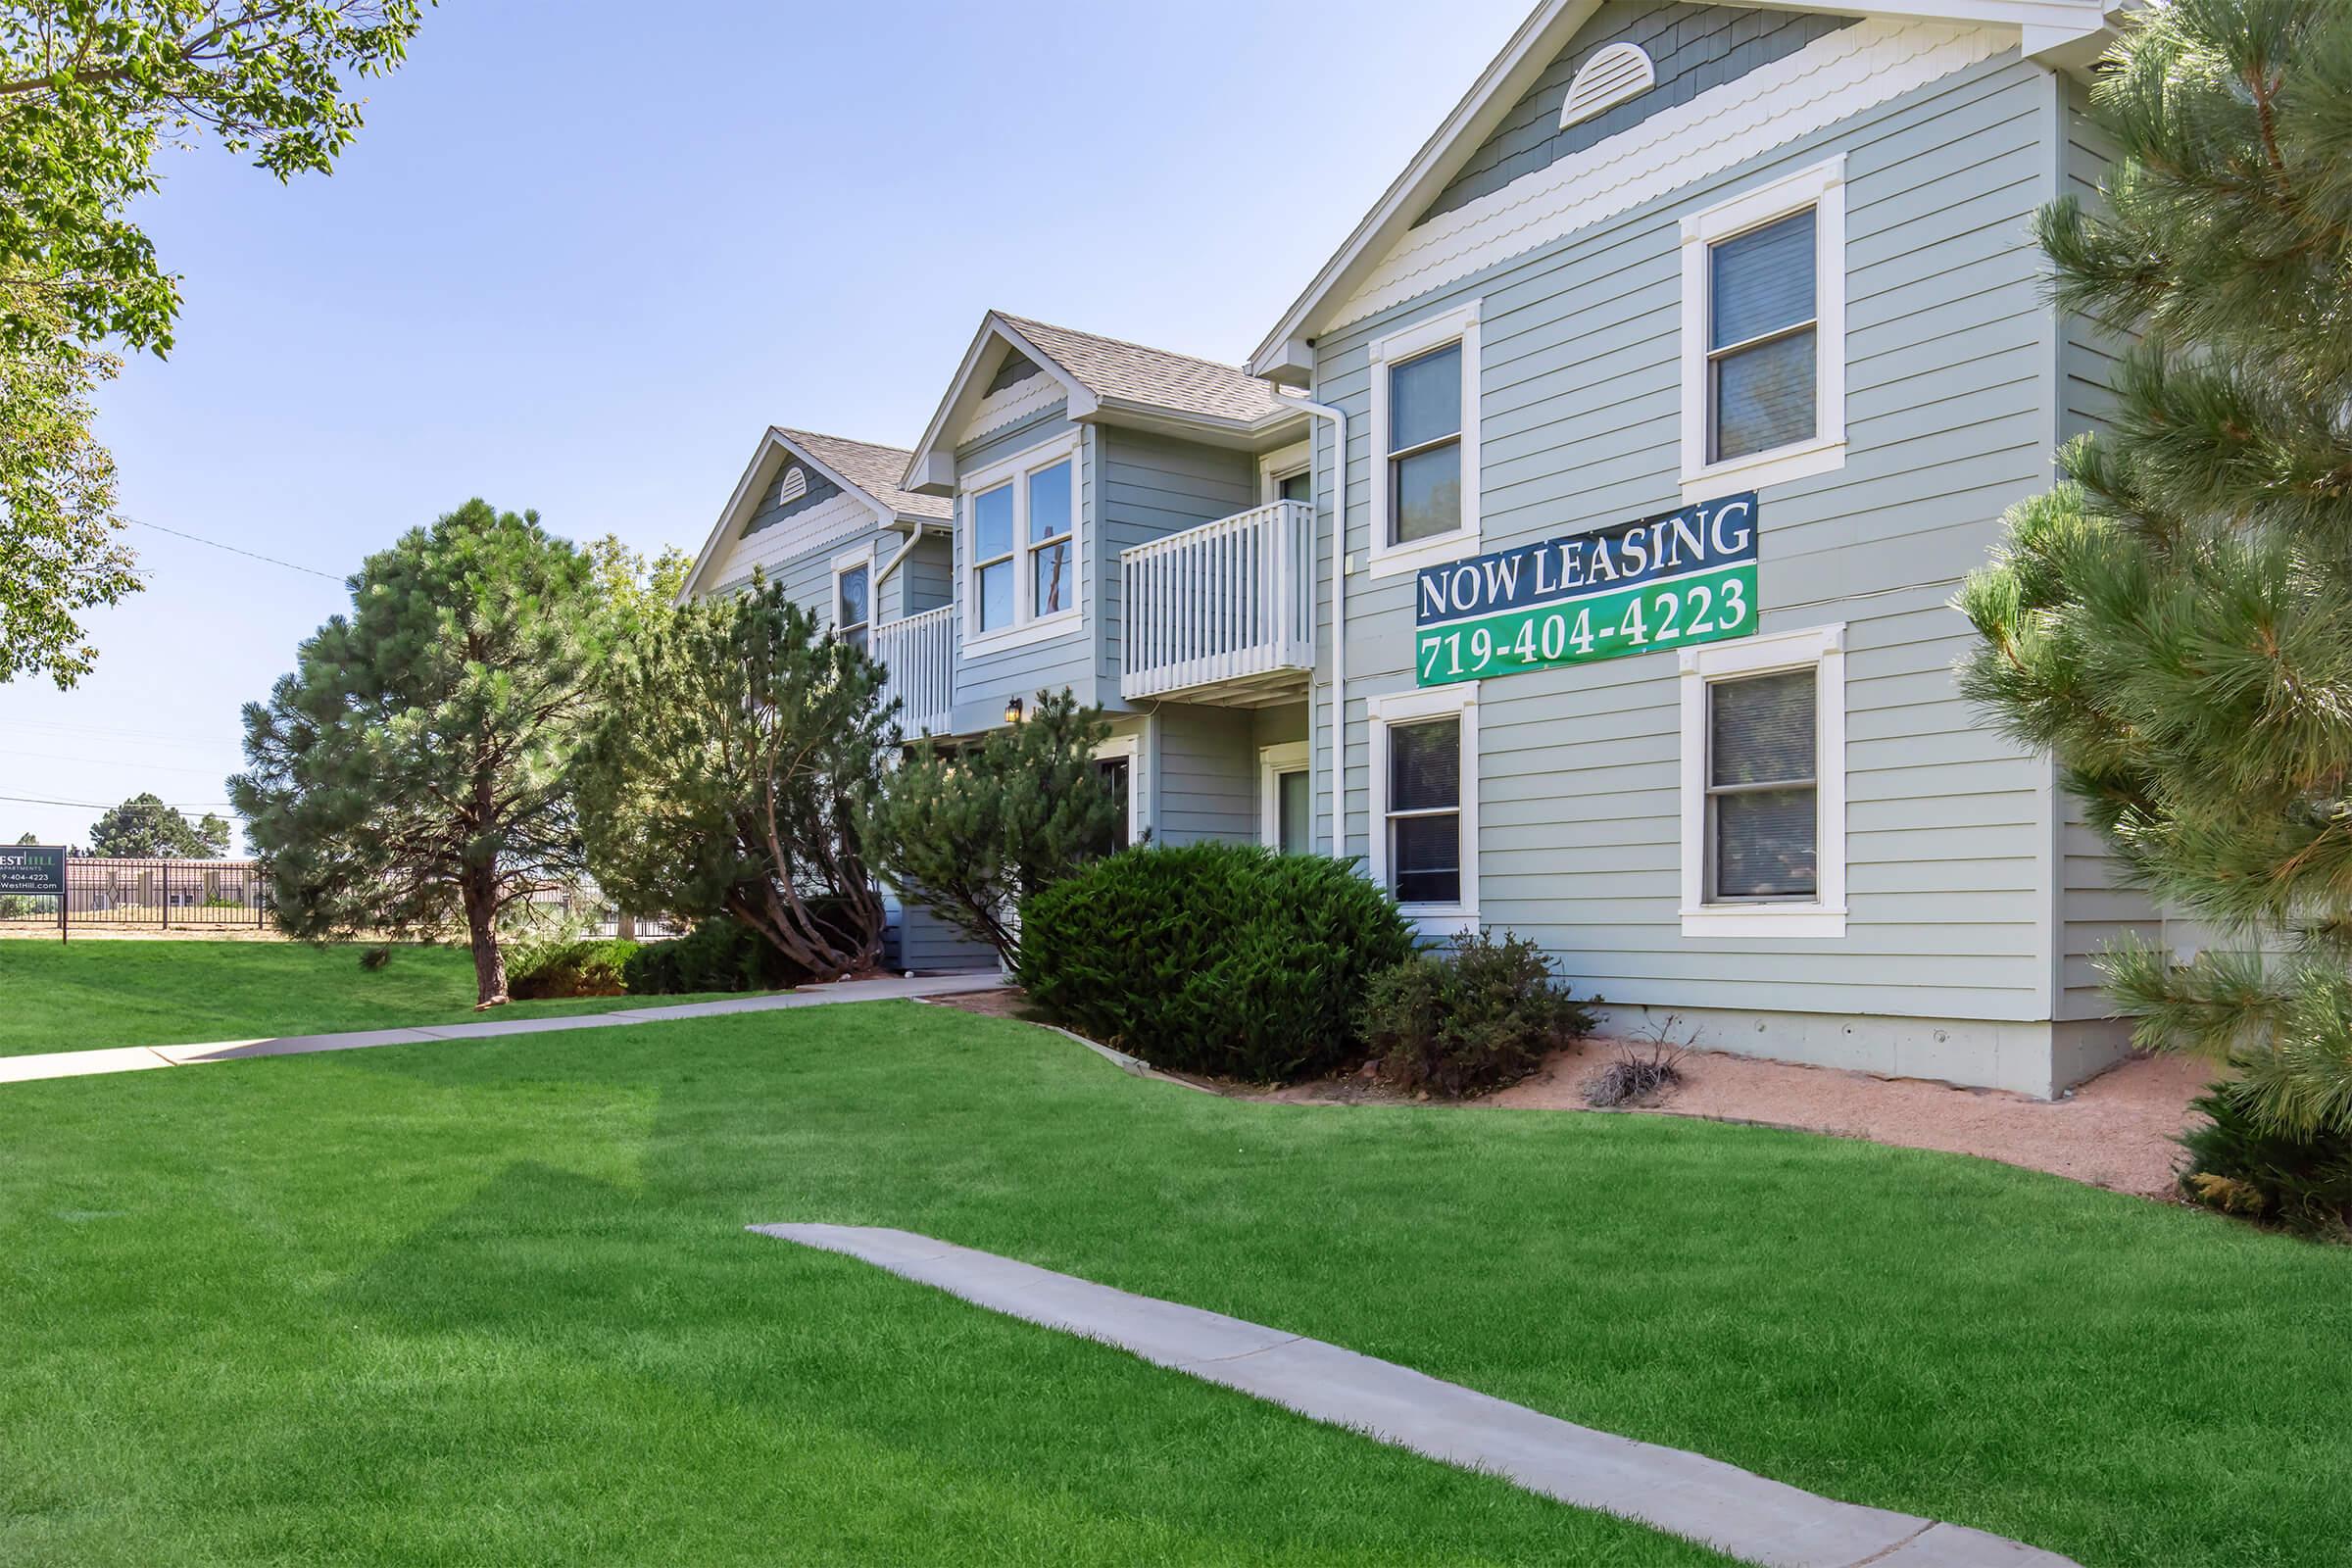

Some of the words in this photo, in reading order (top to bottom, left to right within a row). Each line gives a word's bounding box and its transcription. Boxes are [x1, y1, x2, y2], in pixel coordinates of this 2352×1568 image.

[1421, 555, 1520, 616] NOW
[1534, 502, 1750, 594] LEASING
[1421, 578, 1747, 679] 719-404-4223
